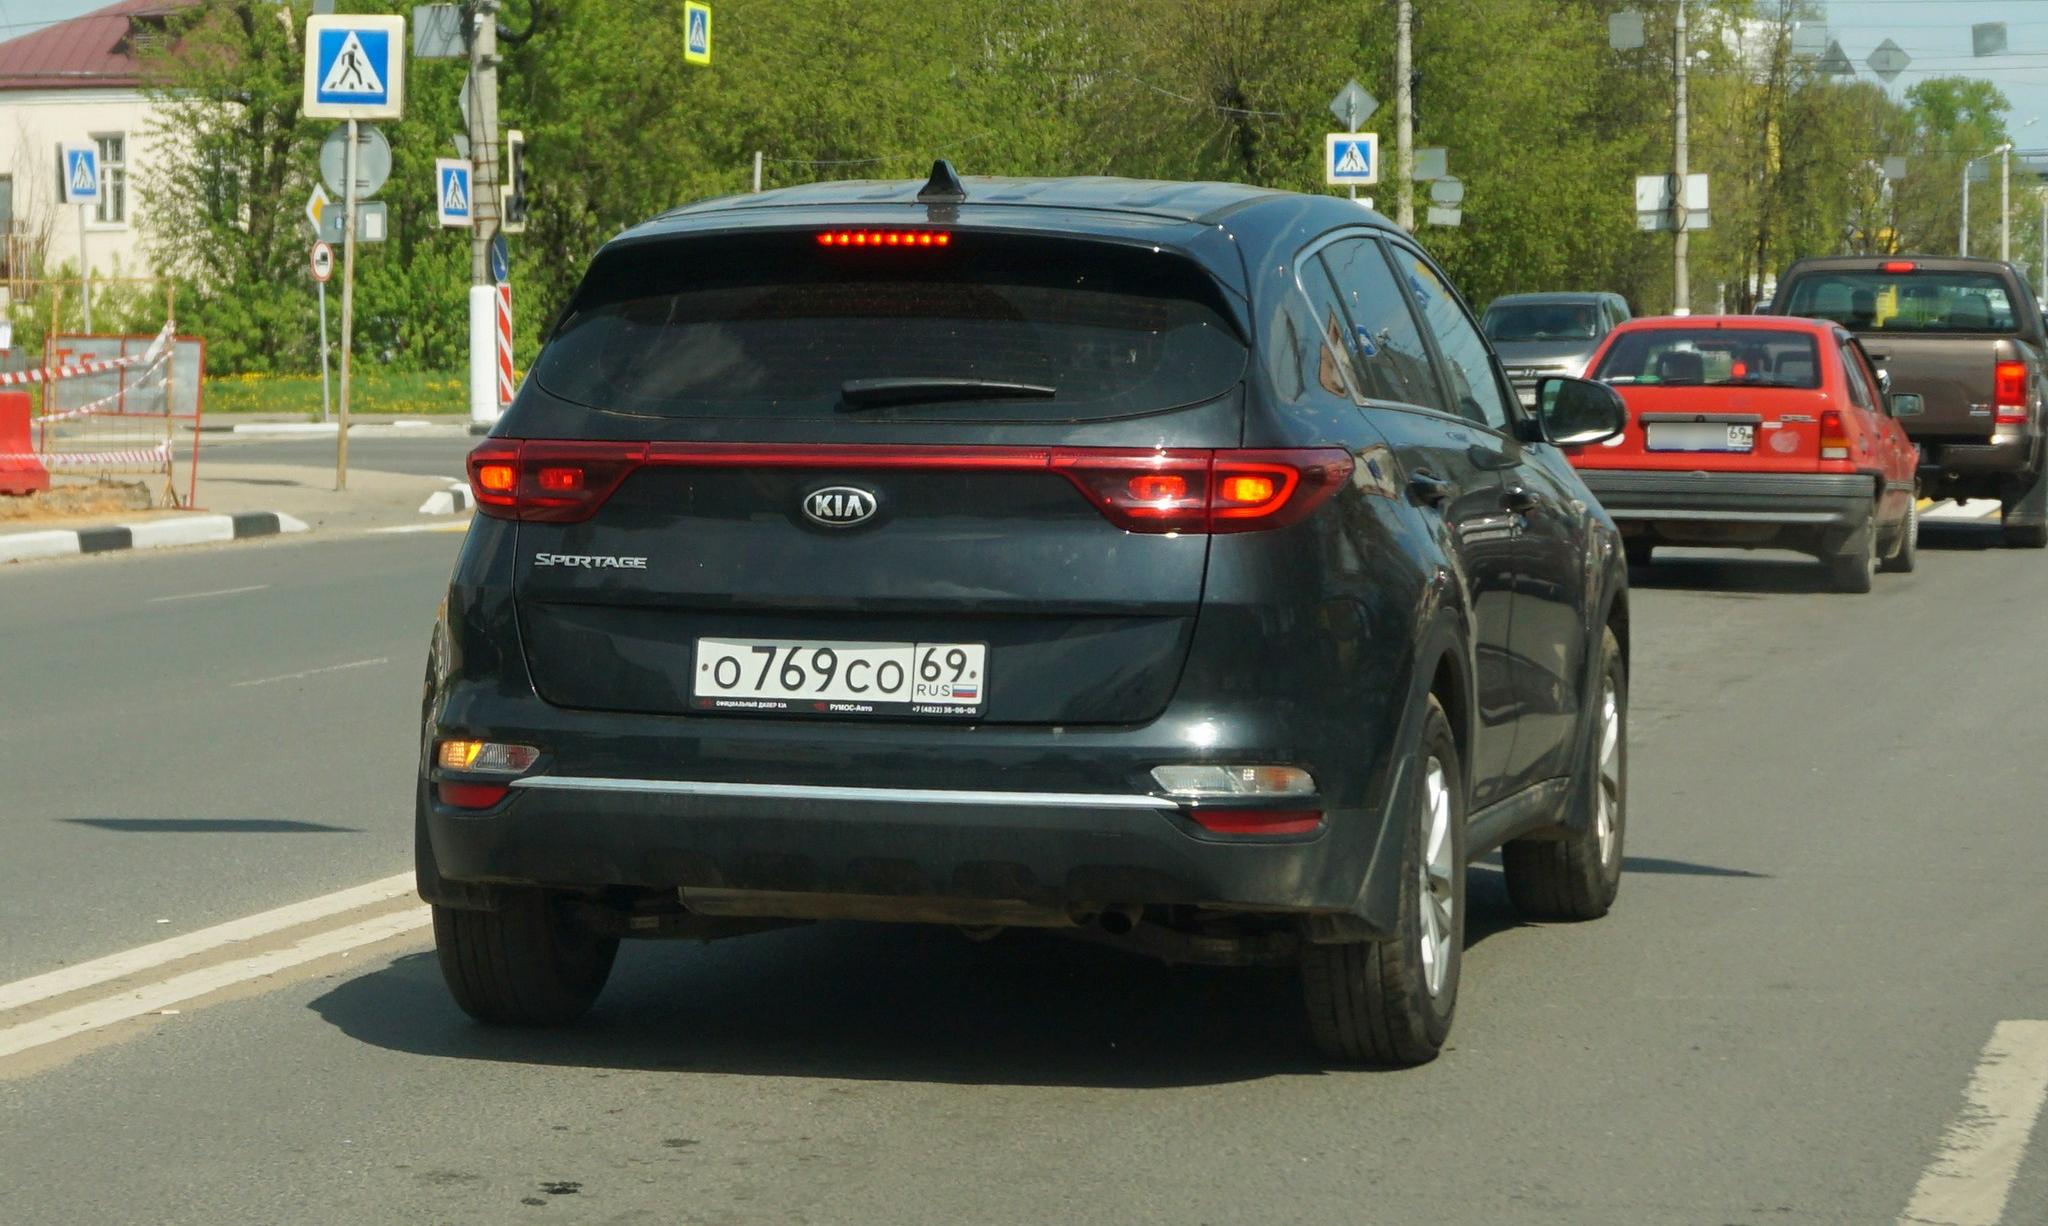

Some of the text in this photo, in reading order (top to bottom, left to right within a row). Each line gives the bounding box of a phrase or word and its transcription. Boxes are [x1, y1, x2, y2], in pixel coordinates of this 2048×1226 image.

[1729, 426, 1746, 440] 69
[815, 495, 864, 517] KIA
[534, 553, 648, 570] SPORTAGE
[919, 647, 967, 683] 69
[916, 684, 950, 697] RUS
[829, 703, 873, 712] РУМОС-Авто
